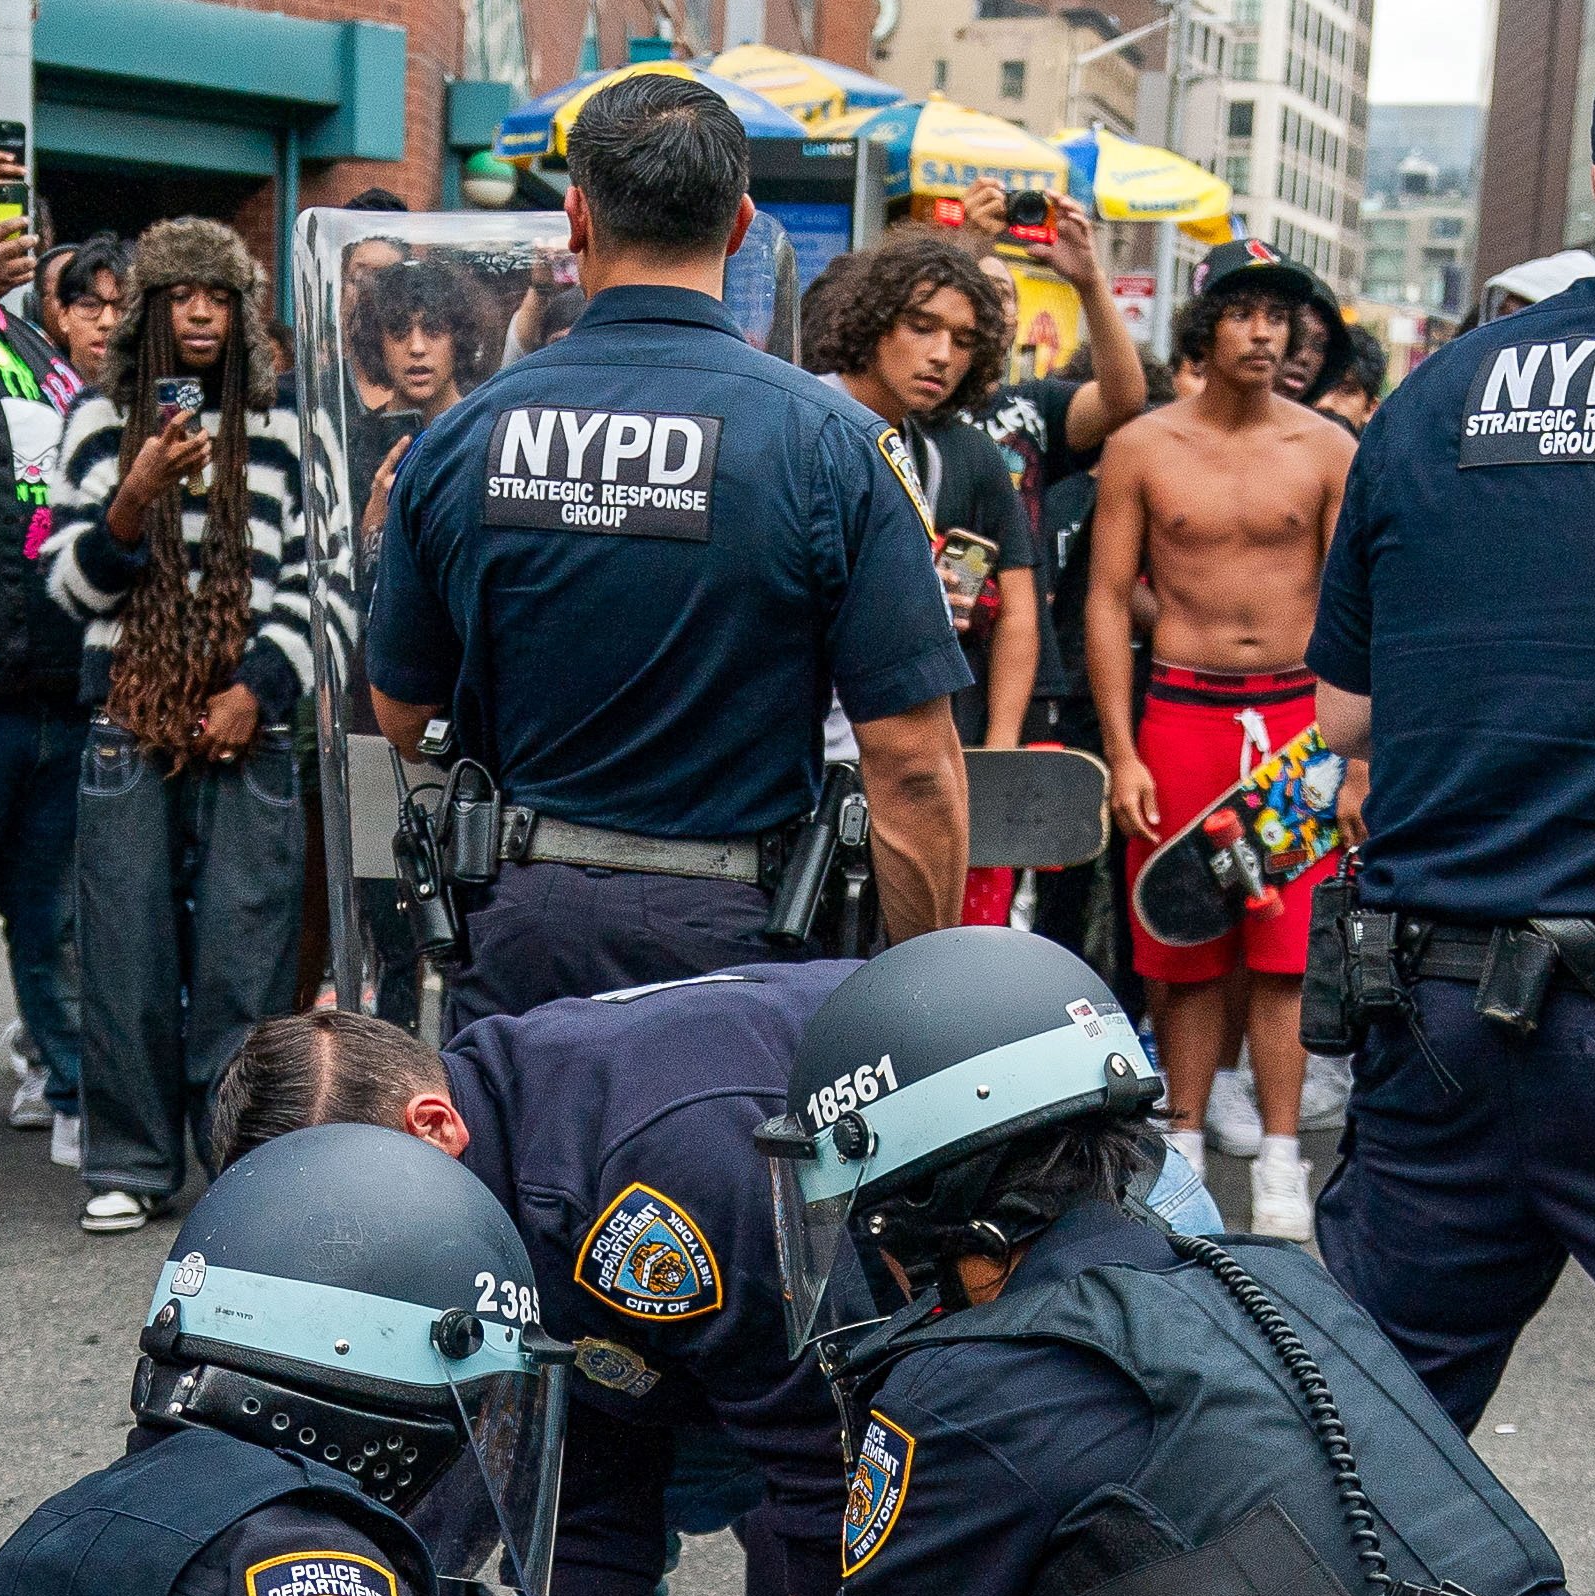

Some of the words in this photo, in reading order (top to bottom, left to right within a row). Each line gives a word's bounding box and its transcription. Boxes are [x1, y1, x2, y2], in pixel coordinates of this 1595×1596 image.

[1465, 409, 1577, 437] STRATEGIC
[499, 409, 703, 486] NYPD
[487, 476, 594, 504] STRATEGIC
[601, 483, 708, 512] RESPONSE
[561, 502, 628, 528] GROUP
[1083, 1020, 1103, 1038] DOT
[807, 1053, 899, 1130] 18561
[591, 1209, 632, 1264] POLICE
[598, 1202, 661, 1292] DEPARTMENT
[667, 1211, 700, 1255] YORK
[174, 1267, 204, 1286] DOT
[694, 1254, 714, 1287] NEW
[625, 1297, 664, 1314] CITY
[667, 1300, 691, 1313] OF
[853, 1528, 878, 1560] NEW
[875, 1486, 900, 1531] YORK
[290, 1563, 362, 1584] POLICE
